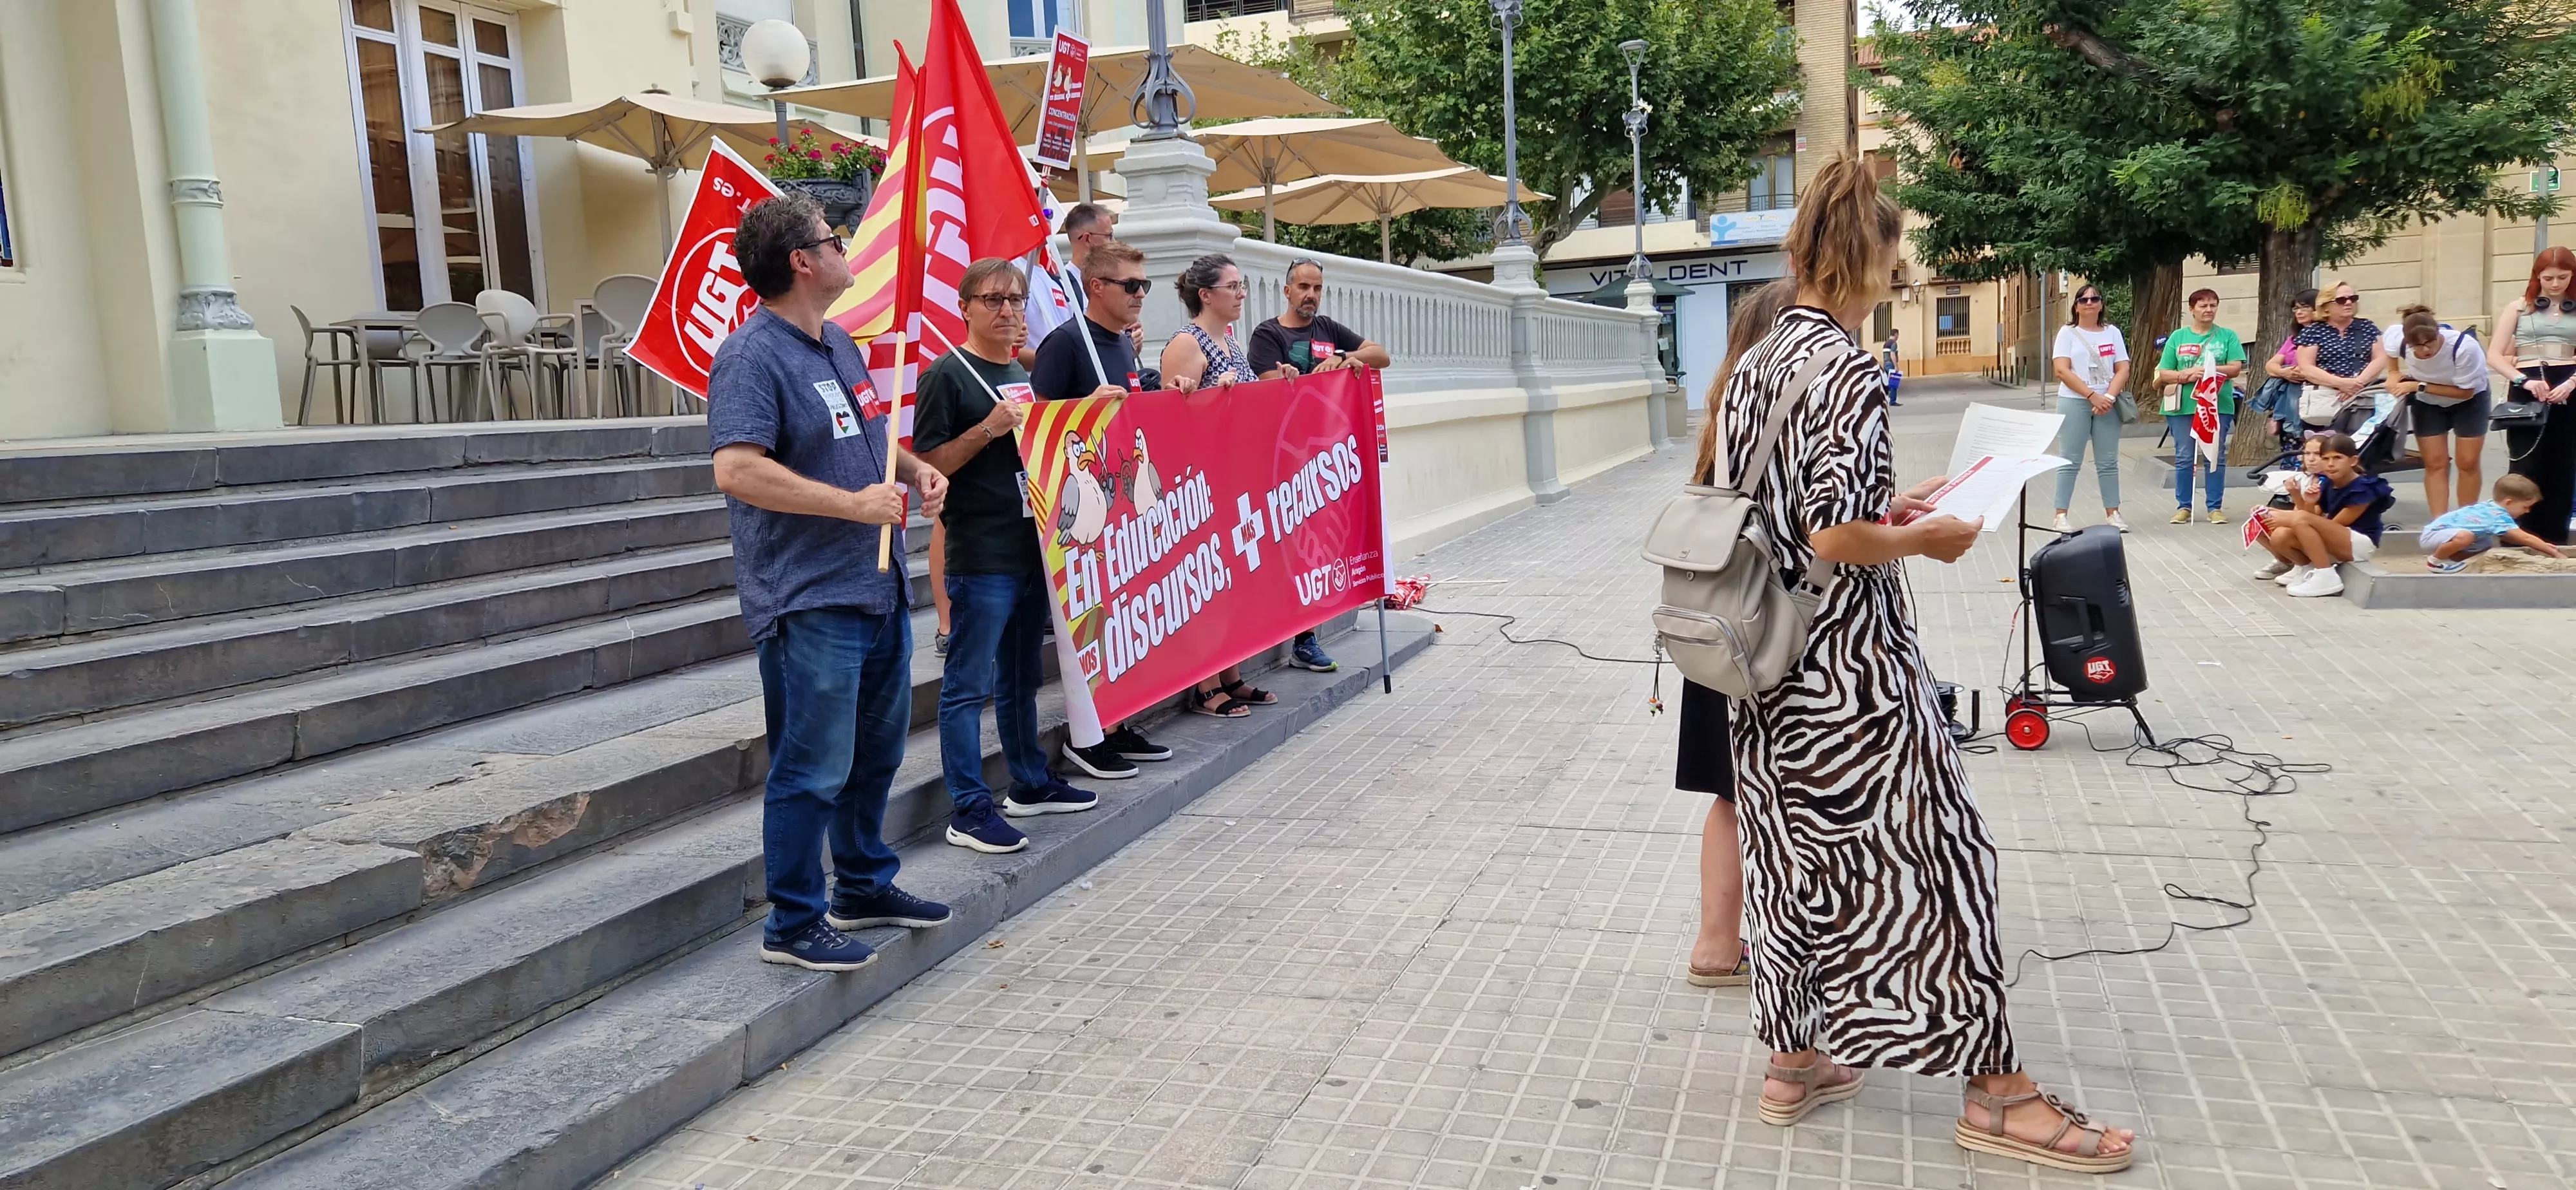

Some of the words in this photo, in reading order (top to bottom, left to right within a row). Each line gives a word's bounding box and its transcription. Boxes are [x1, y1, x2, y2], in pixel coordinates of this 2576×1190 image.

[1058, 39, 1070, 55] UGT
[1589, 260, 1748, 286] VITLDENT
[684, 241, 747, 359] UGT
[1312, 343, 1324, 352] UGT
[819, 382, 836, 393] STOP
[856, 389, 873, 406] UGT
[1240, 517, 1256, 546] MÁS
[1266, 433, 1363, 543] recursos
[1928, 491, 1946, 503] NOTA
[1065, 546, 1102, 621] En
[1103, 464, 1215, 594] Educación:
[1349, 550, 1379, 565] Enseñanza
[1352, 565, 1367, 577] Aragón
[1295, 563, 1332, 606] UGT
[1079, 646, 1097, 678] NOS
[1104, 533, 1231, 684] discursos,
[2087, 660, 2110, 674] UGT
